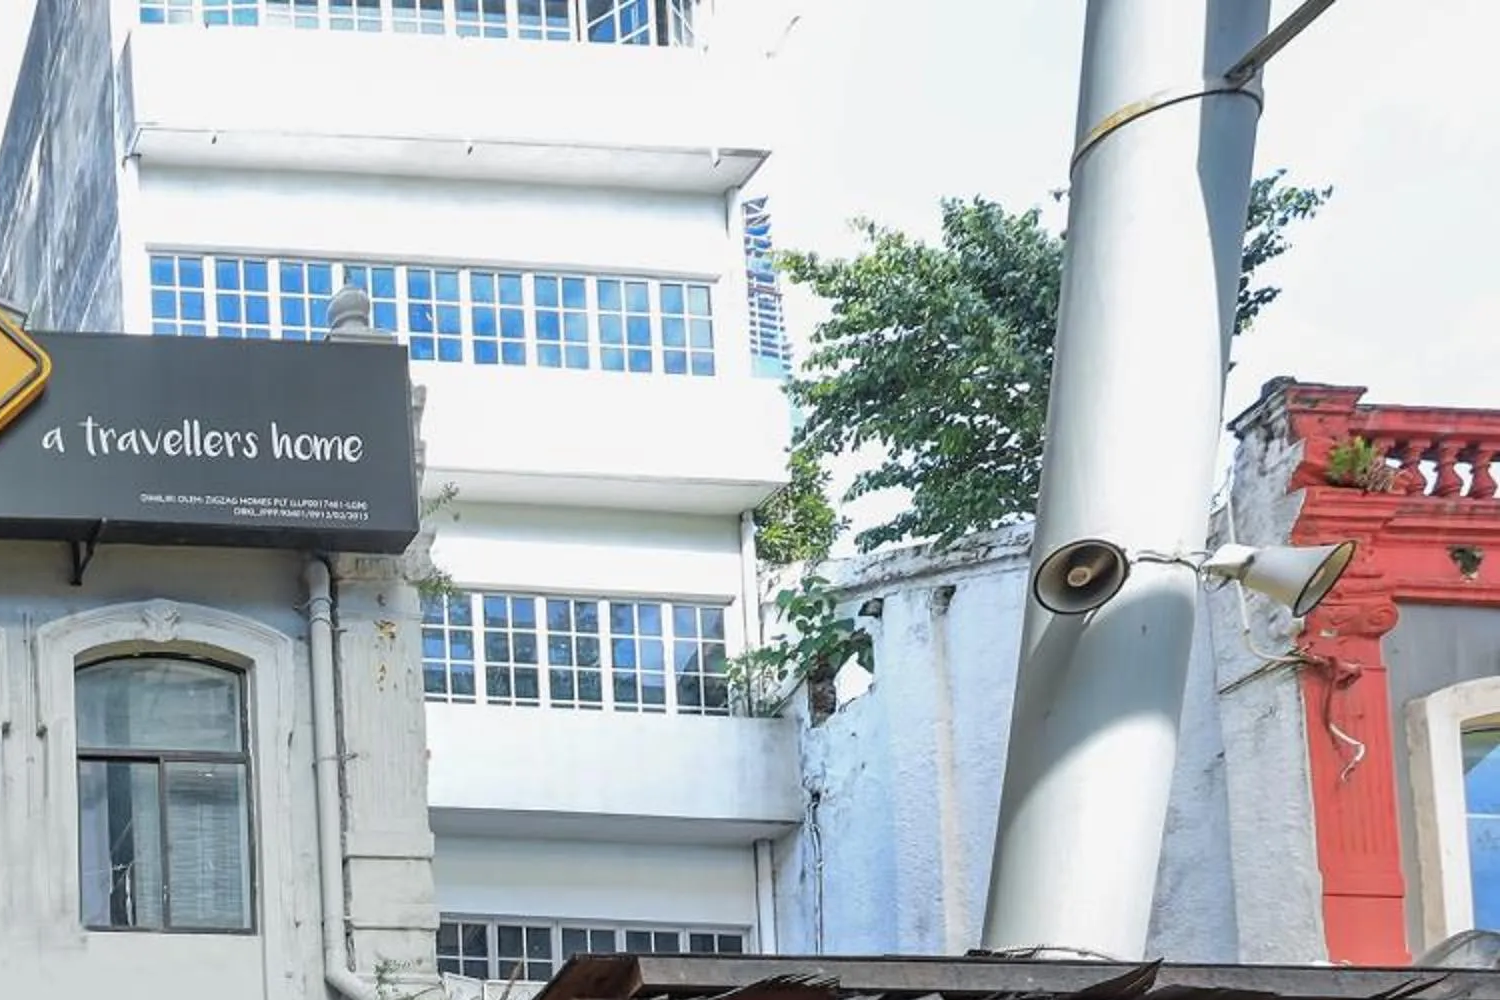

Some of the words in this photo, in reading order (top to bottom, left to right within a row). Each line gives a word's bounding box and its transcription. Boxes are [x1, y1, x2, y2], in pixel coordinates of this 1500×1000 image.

[42, 426, 65, 453] a
[79, 415, 259, 459] travellers
[272, 421, 364, 463] home
